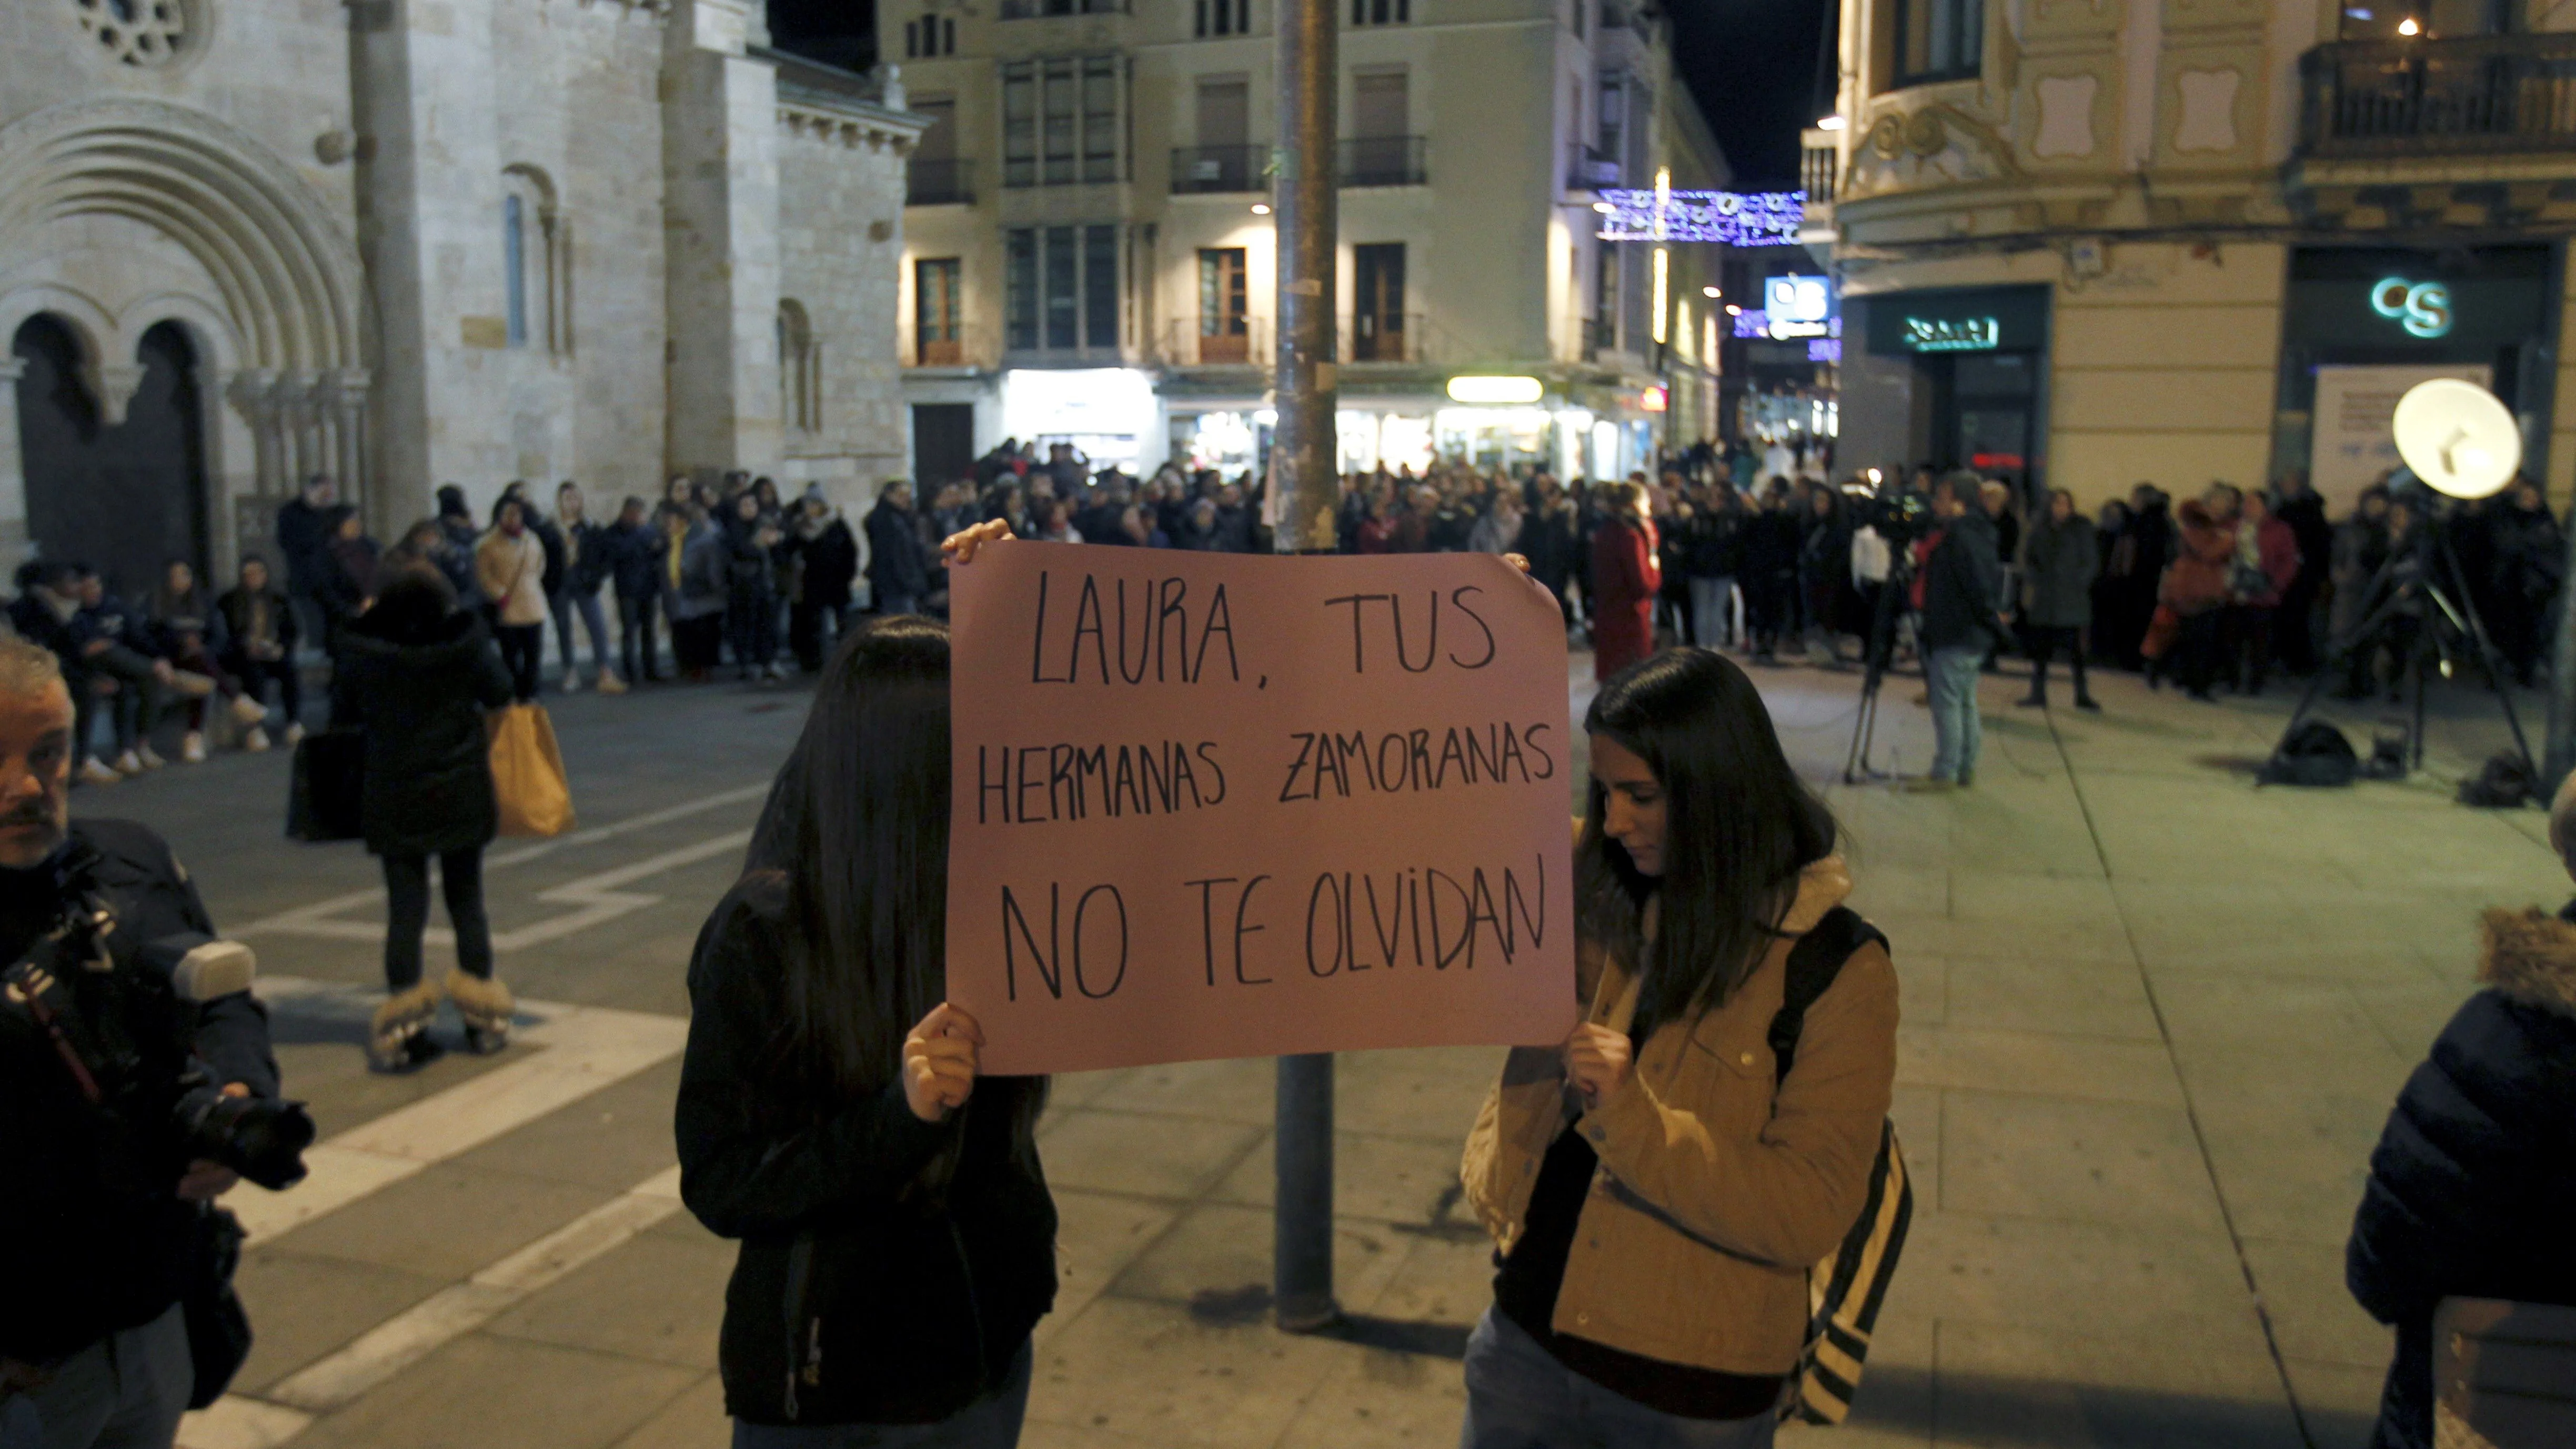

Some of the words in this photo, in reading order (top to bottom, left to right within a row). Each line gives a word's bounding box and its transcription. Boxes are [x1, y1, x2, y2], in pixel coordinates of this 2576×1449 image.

[1033, 571, 1266, 689] LAURA,
[1325, 587, 1495, 673] TUS
[980, 741, 1225, 823] HERMANAS
[1279, 722, 1553, 802] ZAMORANAS
[1002, 882, 1127, 1001] NO
[1184, 876, 1272, 985] TE
